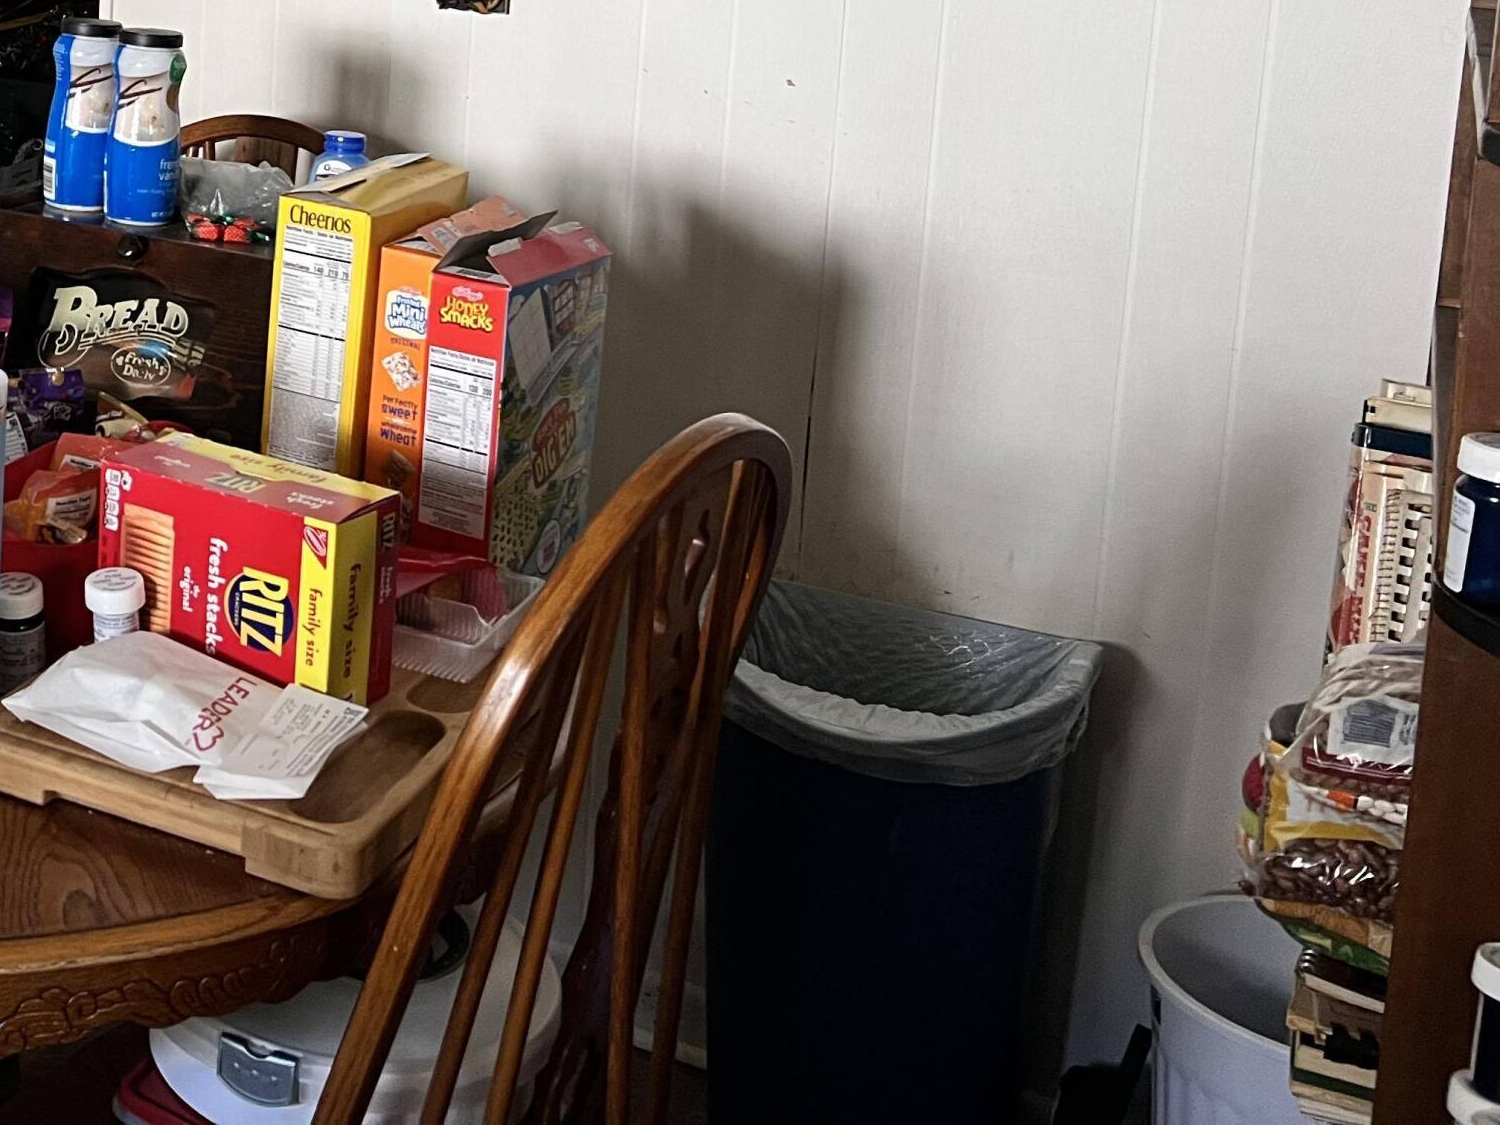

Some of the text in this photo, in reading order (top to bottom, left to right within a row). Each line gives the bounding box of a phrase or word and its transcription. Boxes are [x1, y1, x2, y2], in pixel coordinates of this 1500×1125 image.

[290, 204, 351, 233] Cheerios
[49, 286, 189, 355] BREAD
[392, 303, 426, 321] Mini
[205, 472, 267, 494] RITZ
[268, 463, 326, 483] family
[179, 566, 193, 613] original
[205, 537, 228, 655] fresh stacks
[239, 566, 290, 657] RITZ
[343, 563, 361, 632] family
[302, 587, 323, 667] family size
[344, 640, 356, 678] size
[192, 677, 258, 732] LEADER
